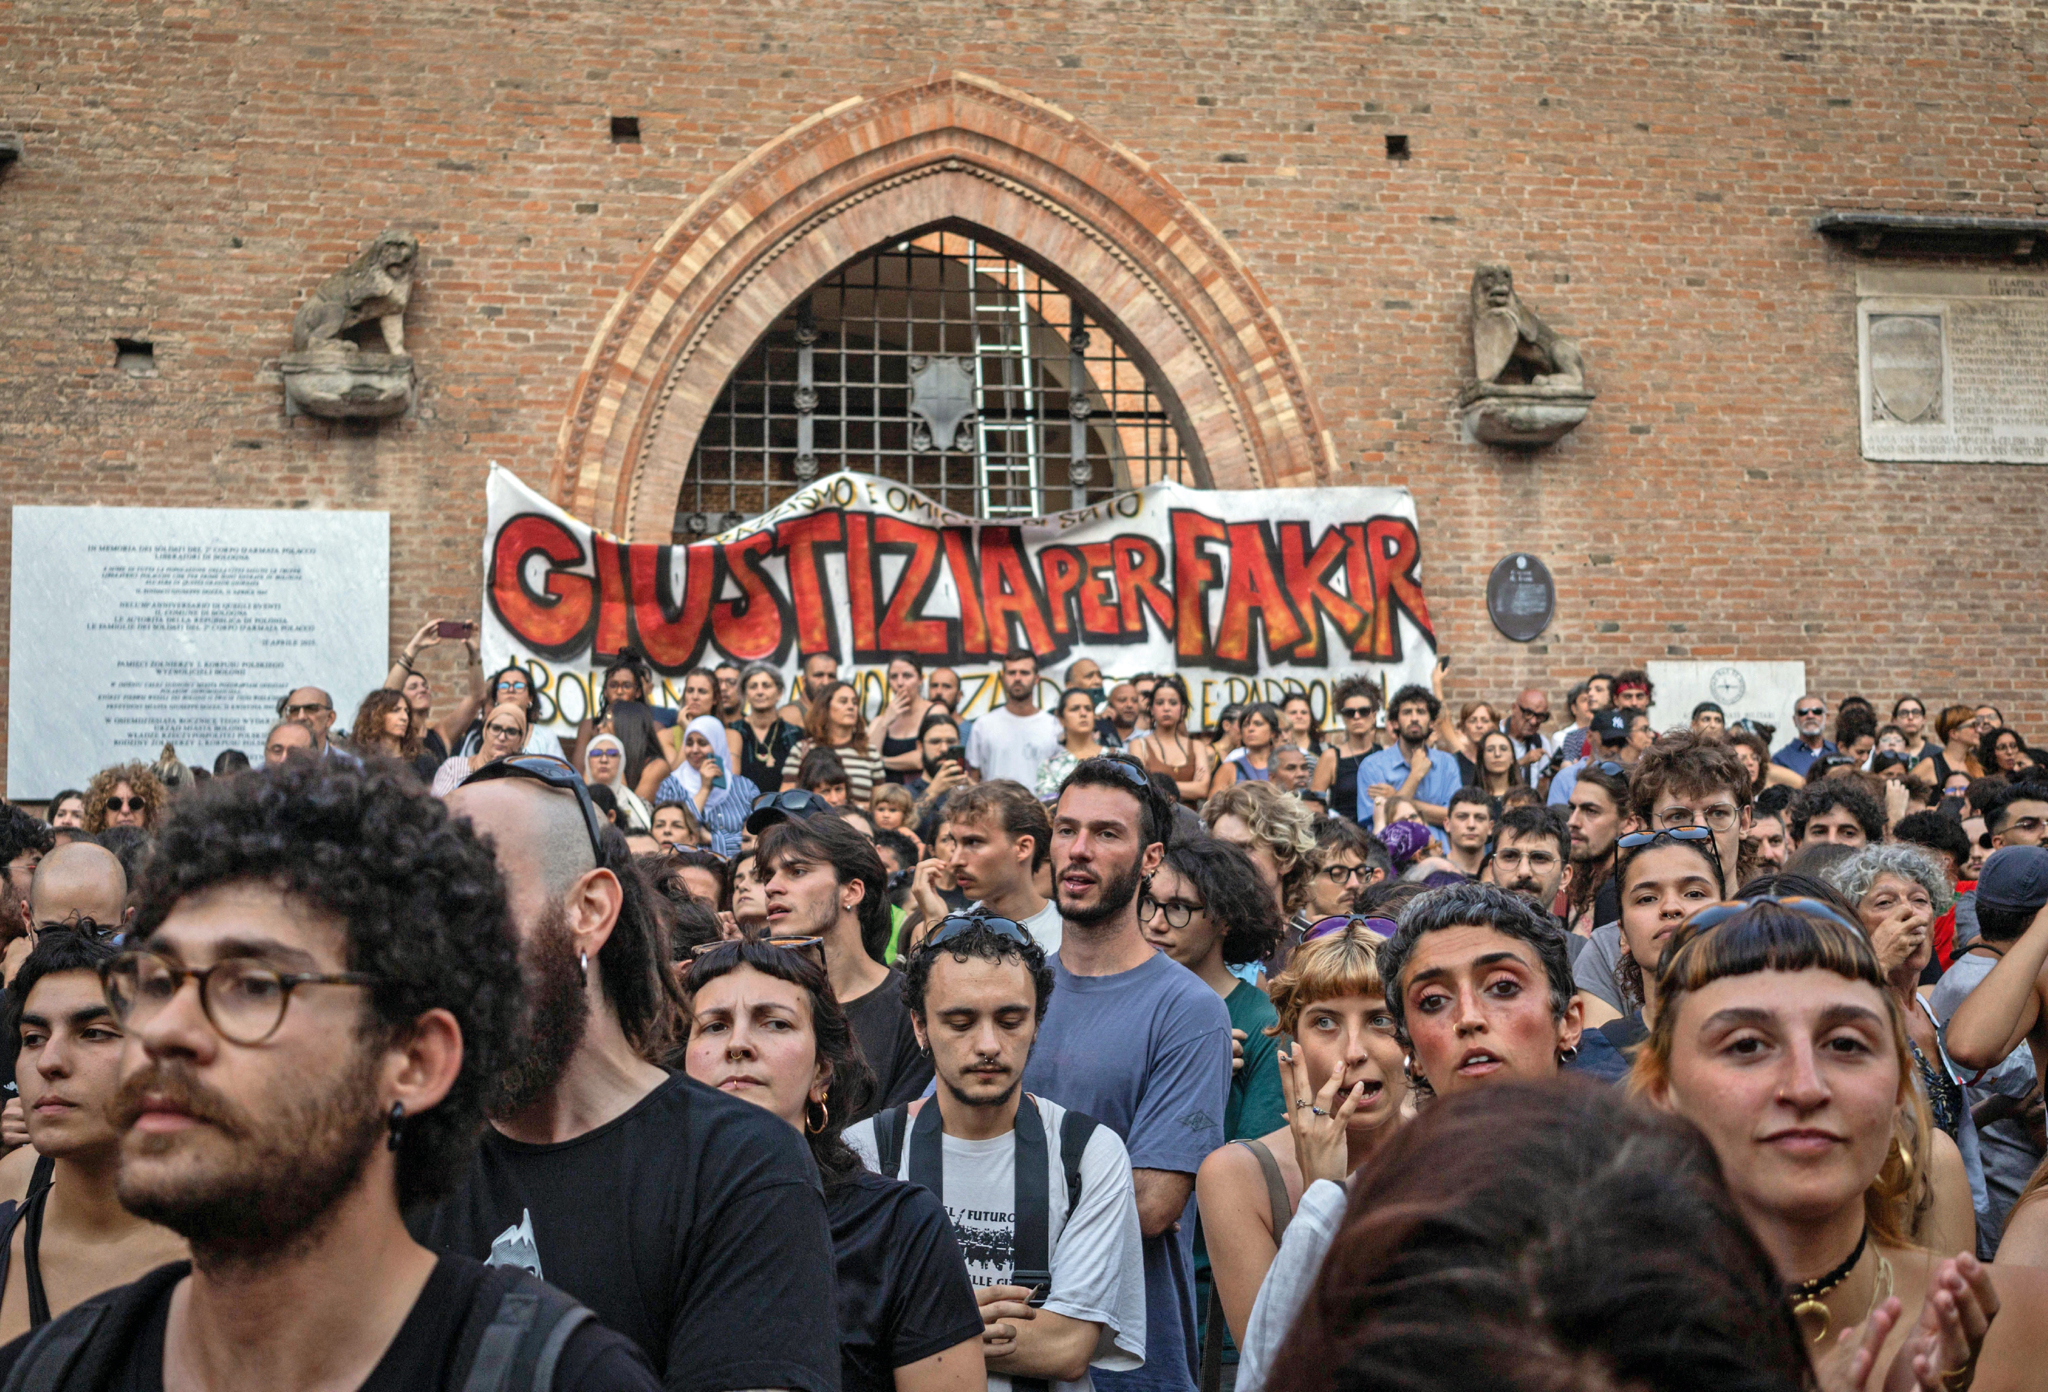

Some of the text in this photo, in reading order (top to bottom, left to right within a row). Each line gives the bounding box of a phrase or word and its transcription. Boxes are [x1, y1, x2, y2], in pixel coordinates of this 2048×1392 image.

[866, 479, 878, 505] E
[487, 507, 1437, 676] GIUSTIZIA PER FAKIR
[1200, 679, 1218, 732] E
[967, 1210, 1016, 1223] FUTURO
